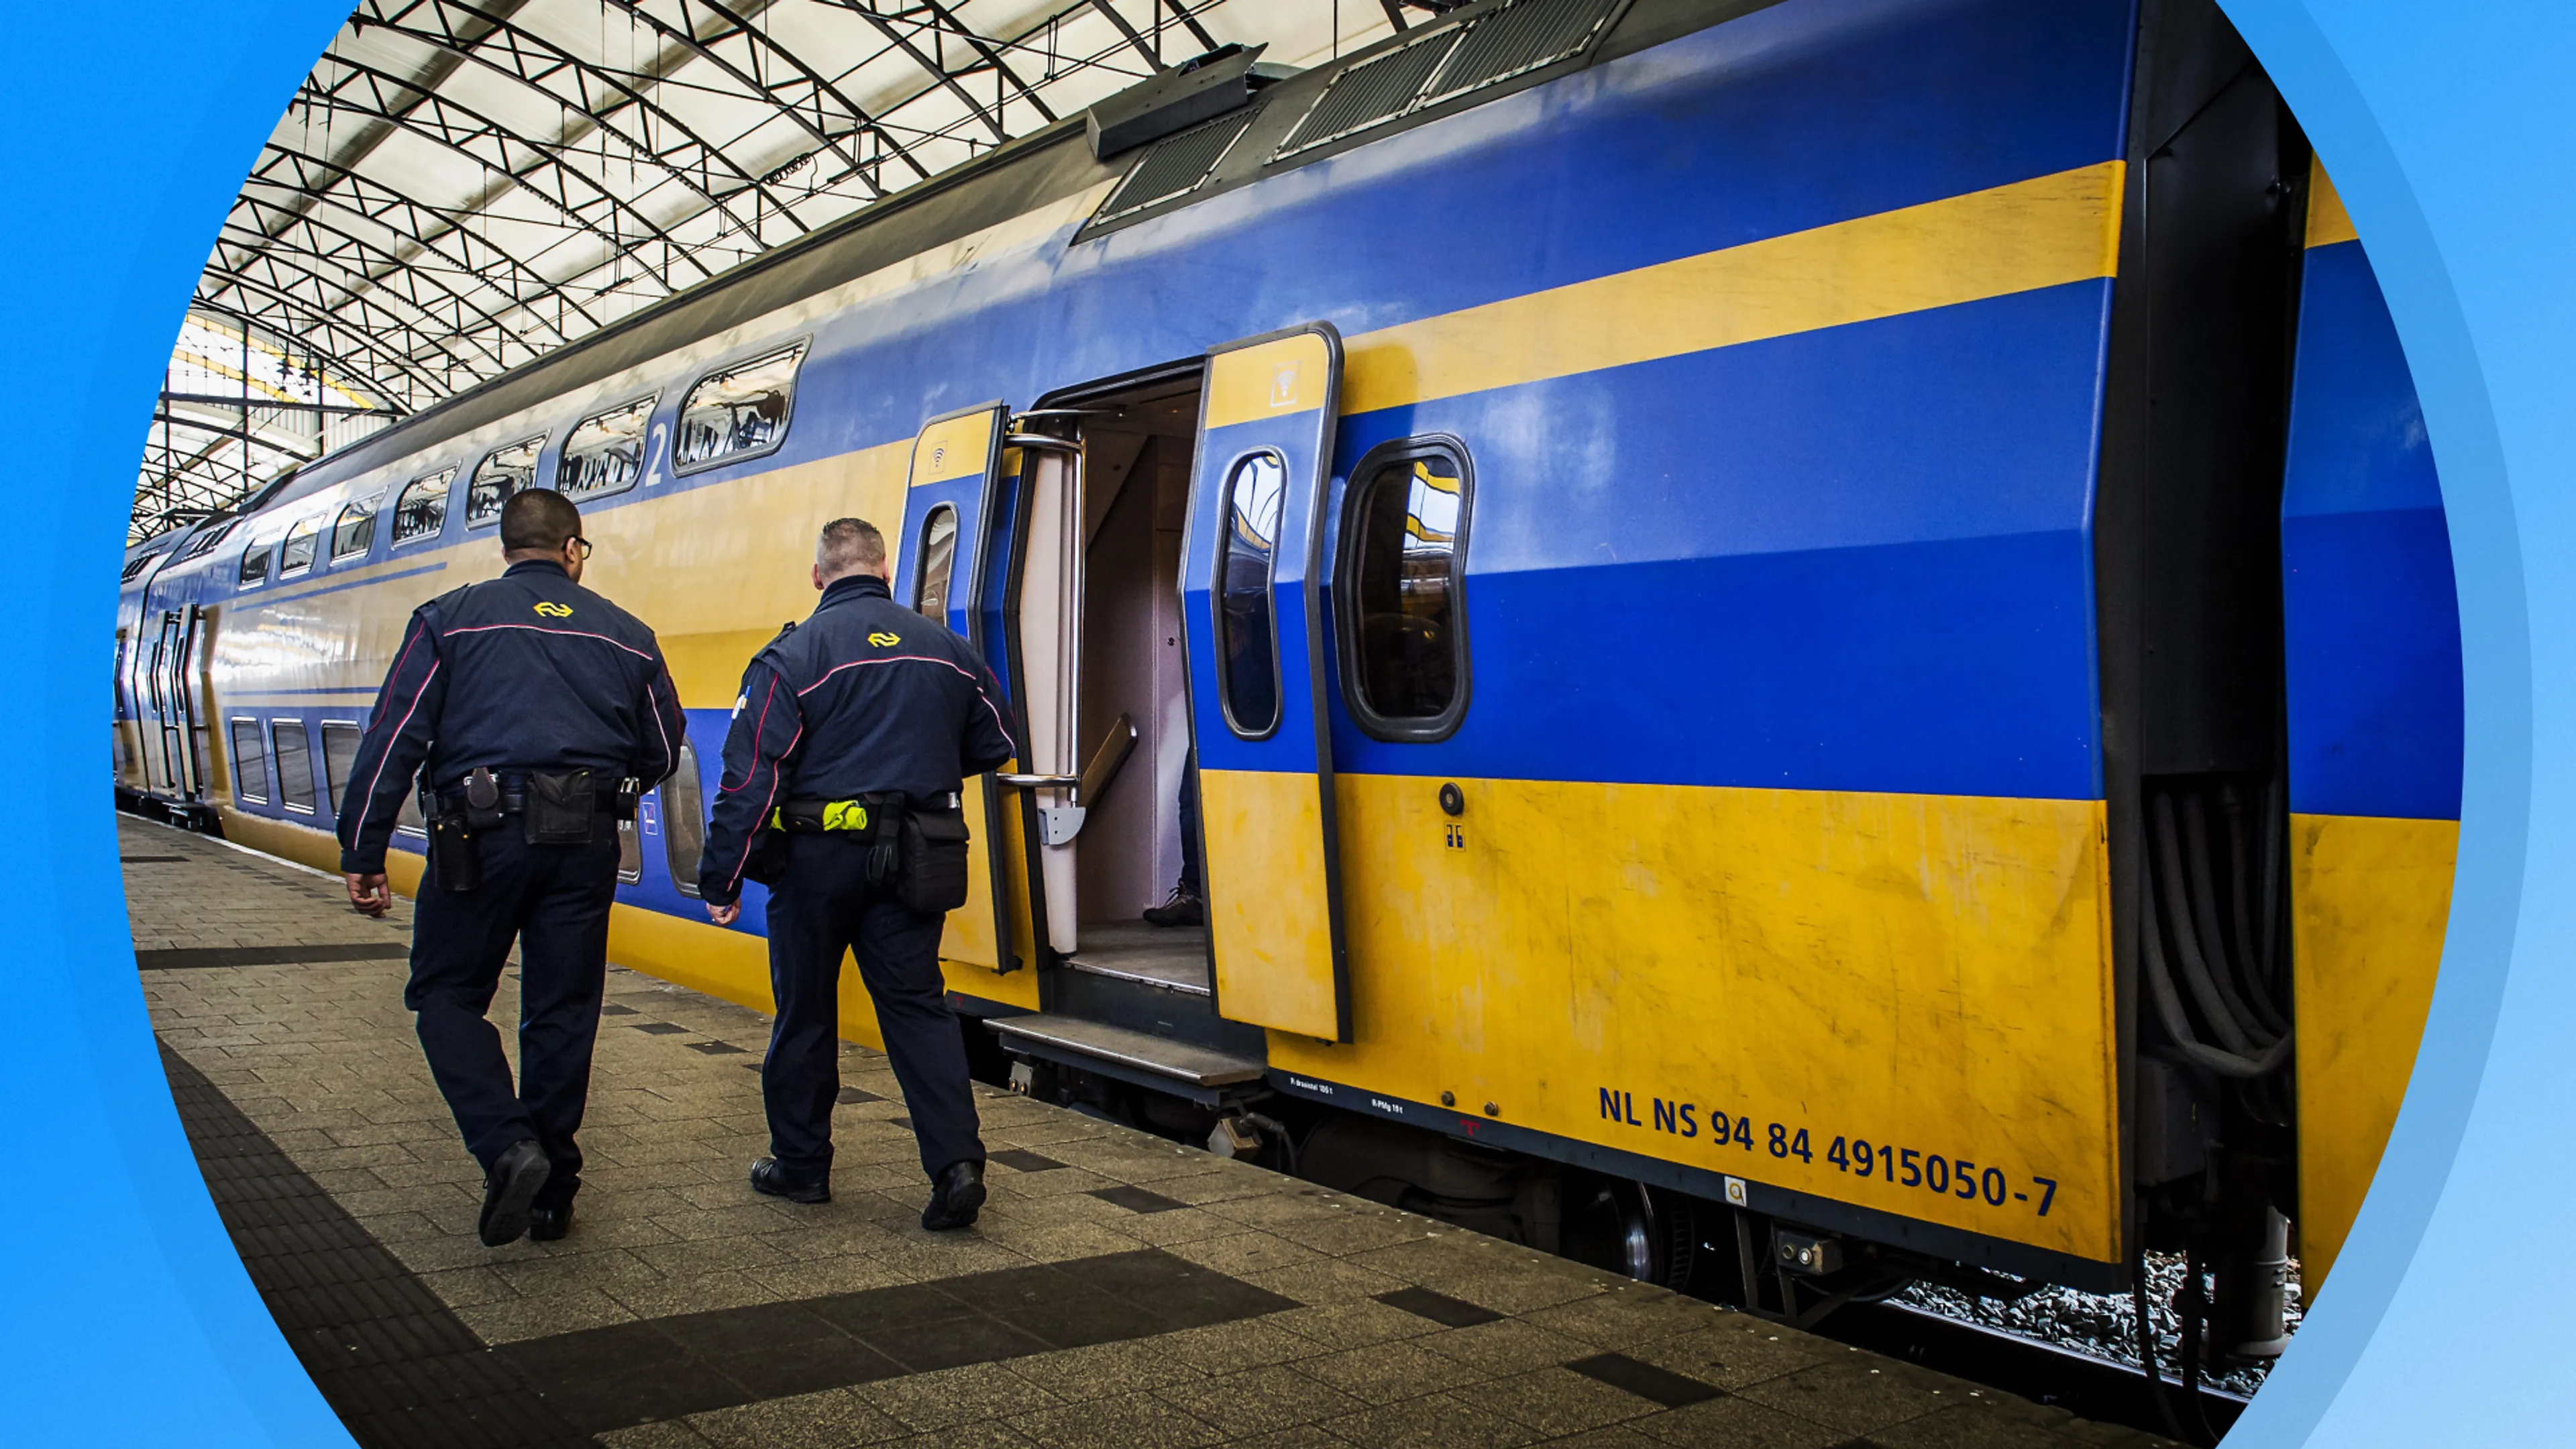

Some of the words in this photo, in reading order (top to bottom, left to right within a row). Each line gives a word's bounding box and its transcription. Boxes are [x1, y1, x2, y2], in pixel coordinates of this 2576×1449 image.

[645, 422, 667, 487] 2
[1599, 1087, 1642, 1127] NL
[1653, 1097, 1698, 1138] NS
[1711, 1110, 1755, 1152] 94
[1768, 1122, 1813, 1165] 84
[1827, 1135, 2057, 1218] 4915050-7
